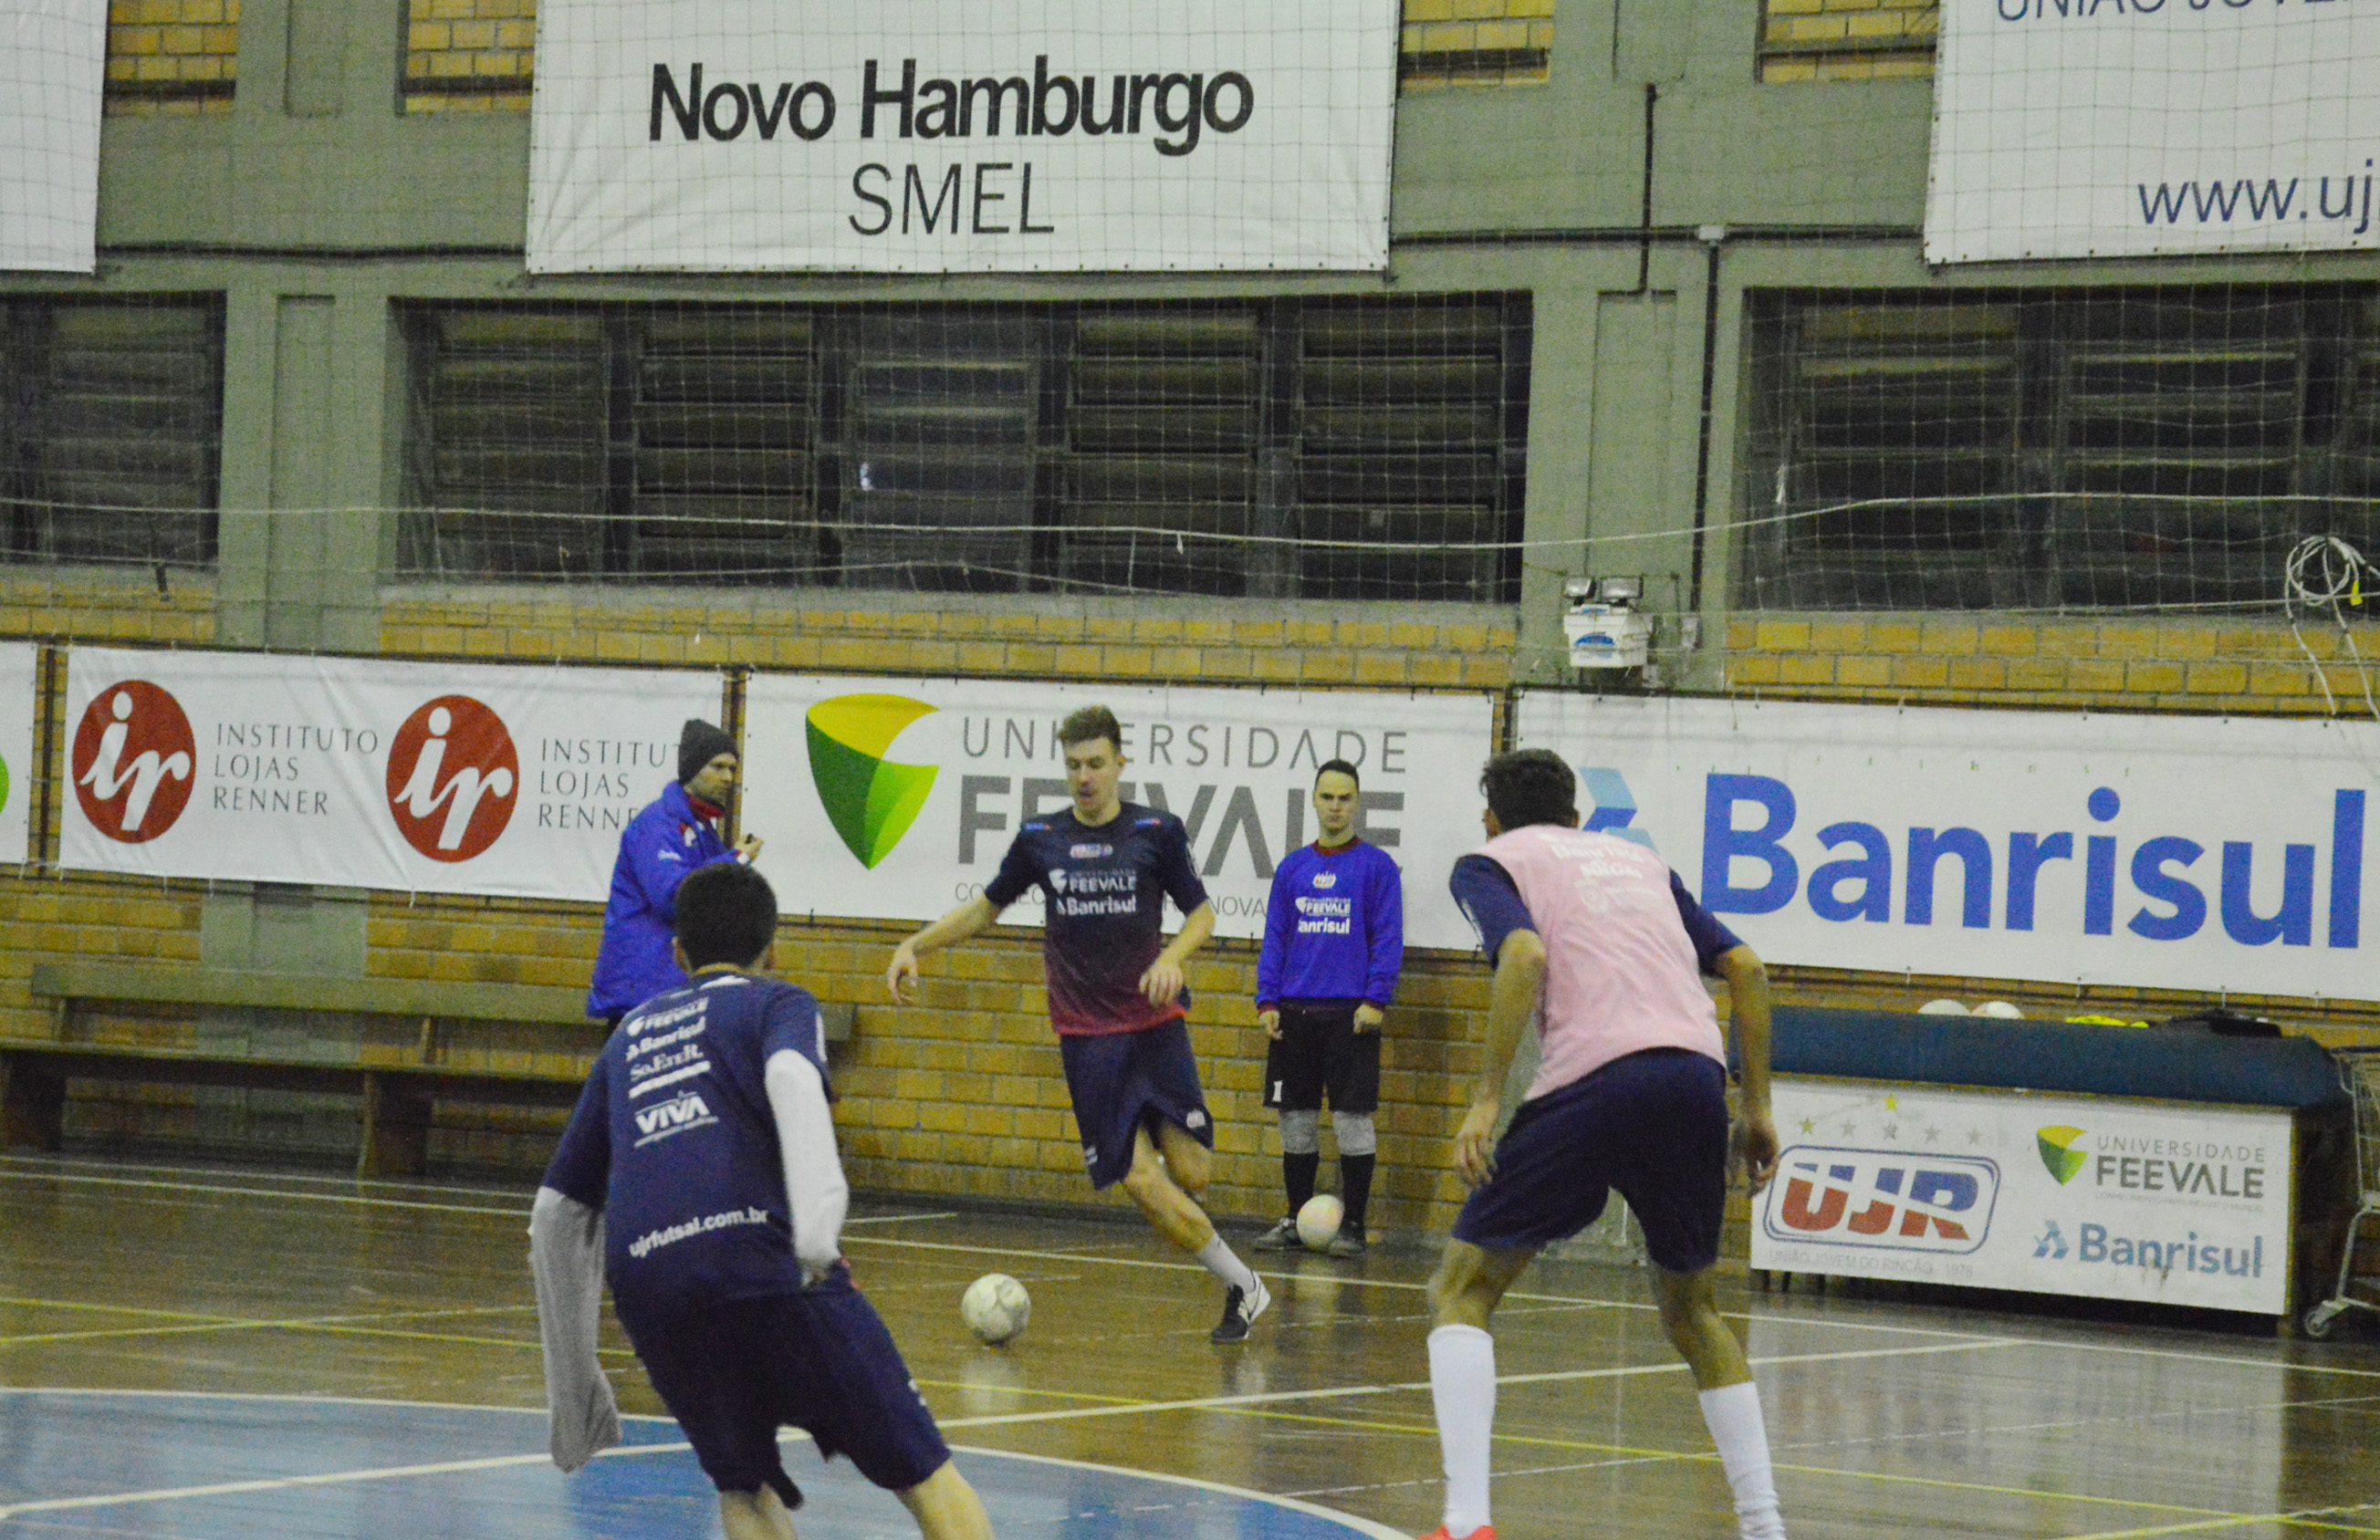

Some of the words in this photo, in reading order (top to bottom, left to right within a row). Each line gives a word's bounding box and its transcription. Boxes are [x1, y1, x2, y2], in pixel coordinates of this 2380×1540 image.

[649, 63, 837, 142] Novo
[860, 55, 1255, 157] Hamburgo
[849, 162, 1056, 236] SMEL
[2137, 158, 2380, 235] www.uj
[216, 723, 378, 755] INSTITUTO
[541, 737, 681, 768] INSTITU
[963, 716, 1407, 774] UNIERSIDADE
[214, 754, 299, 785] LOJAS
[540, 769, 629, 800] LOJAS
[214, 786, 329, 816] RENNER
[538, 802, 640, 831] RENNE
[1700, 774, 2366, 949] Banrisul
[1066, 894, 1137, 917] Banrisul
[1298, 917, 1351, 934] anrisul
[635, 1096, 711, 1135] VIVA
[2097, 1136, 2265, 1163] UNIVERSIDADE
[2096, 1155, 2266, 1199] FEEVALE
[1781, 1161, 1978, 1241] UJR
[2079, 1223, 2263, 1278] Banrisul
